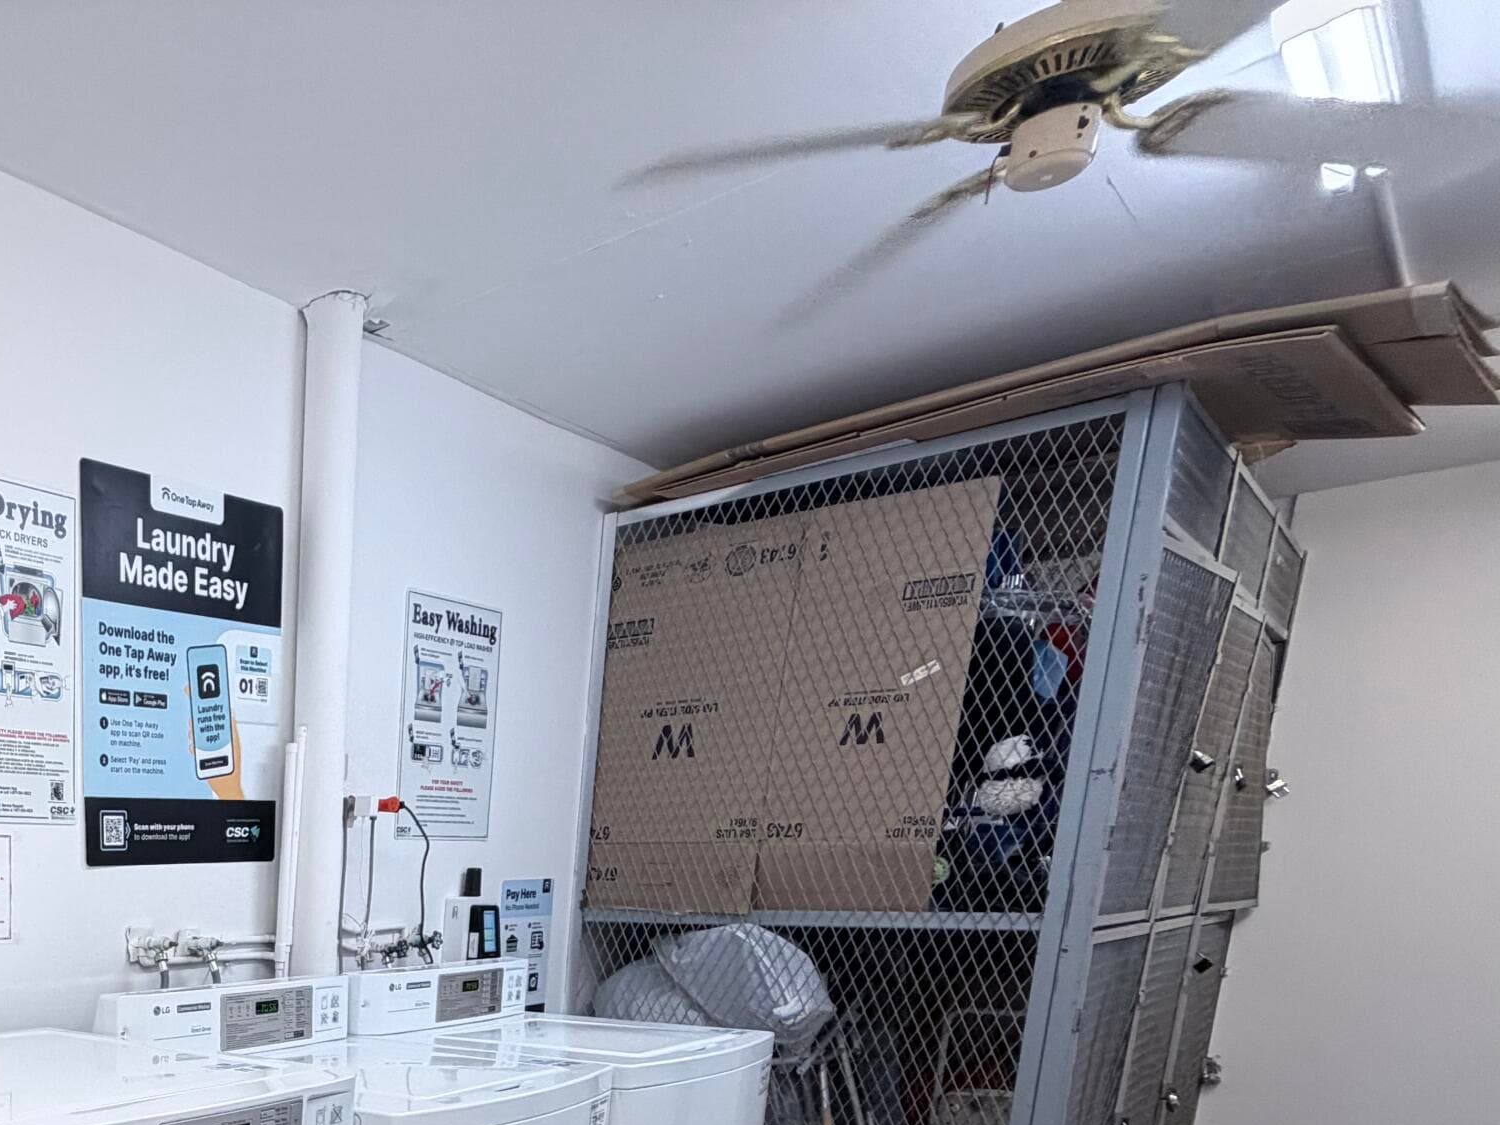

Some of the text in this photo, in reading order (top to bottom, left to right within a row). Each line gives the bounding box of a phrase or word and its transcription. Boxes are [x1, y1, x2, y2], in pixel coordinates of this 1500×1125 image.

[14, 532, 49, 549] DRYERS
[137, 517, 236, 573] Laundry
[120, 552, 248, 610] Made Easy
[412, 603, 498, 645] Easy Washing
[99, 622, 175, 645] Download the
[99, 642, 177, 667] One Tap Away
[99, 663, 170, 681] app, it's free!
[240, 679, 253, 694] 01
[197, 704, 224, 714] Laundry
[135, 721, 144, 730] Tap
[145, 722, 159, 730] Away
[198, 714, 226, 724] runs free
[200, 725, 214, 733] with
[111, 756, 127, 764] Select
[51, 807, 69, 815] CSC
[134, 823, 195, 832] Scan with your phone
[226, 827, 250, 838] CSC
[507, 889, 537, 902] Pay Here
